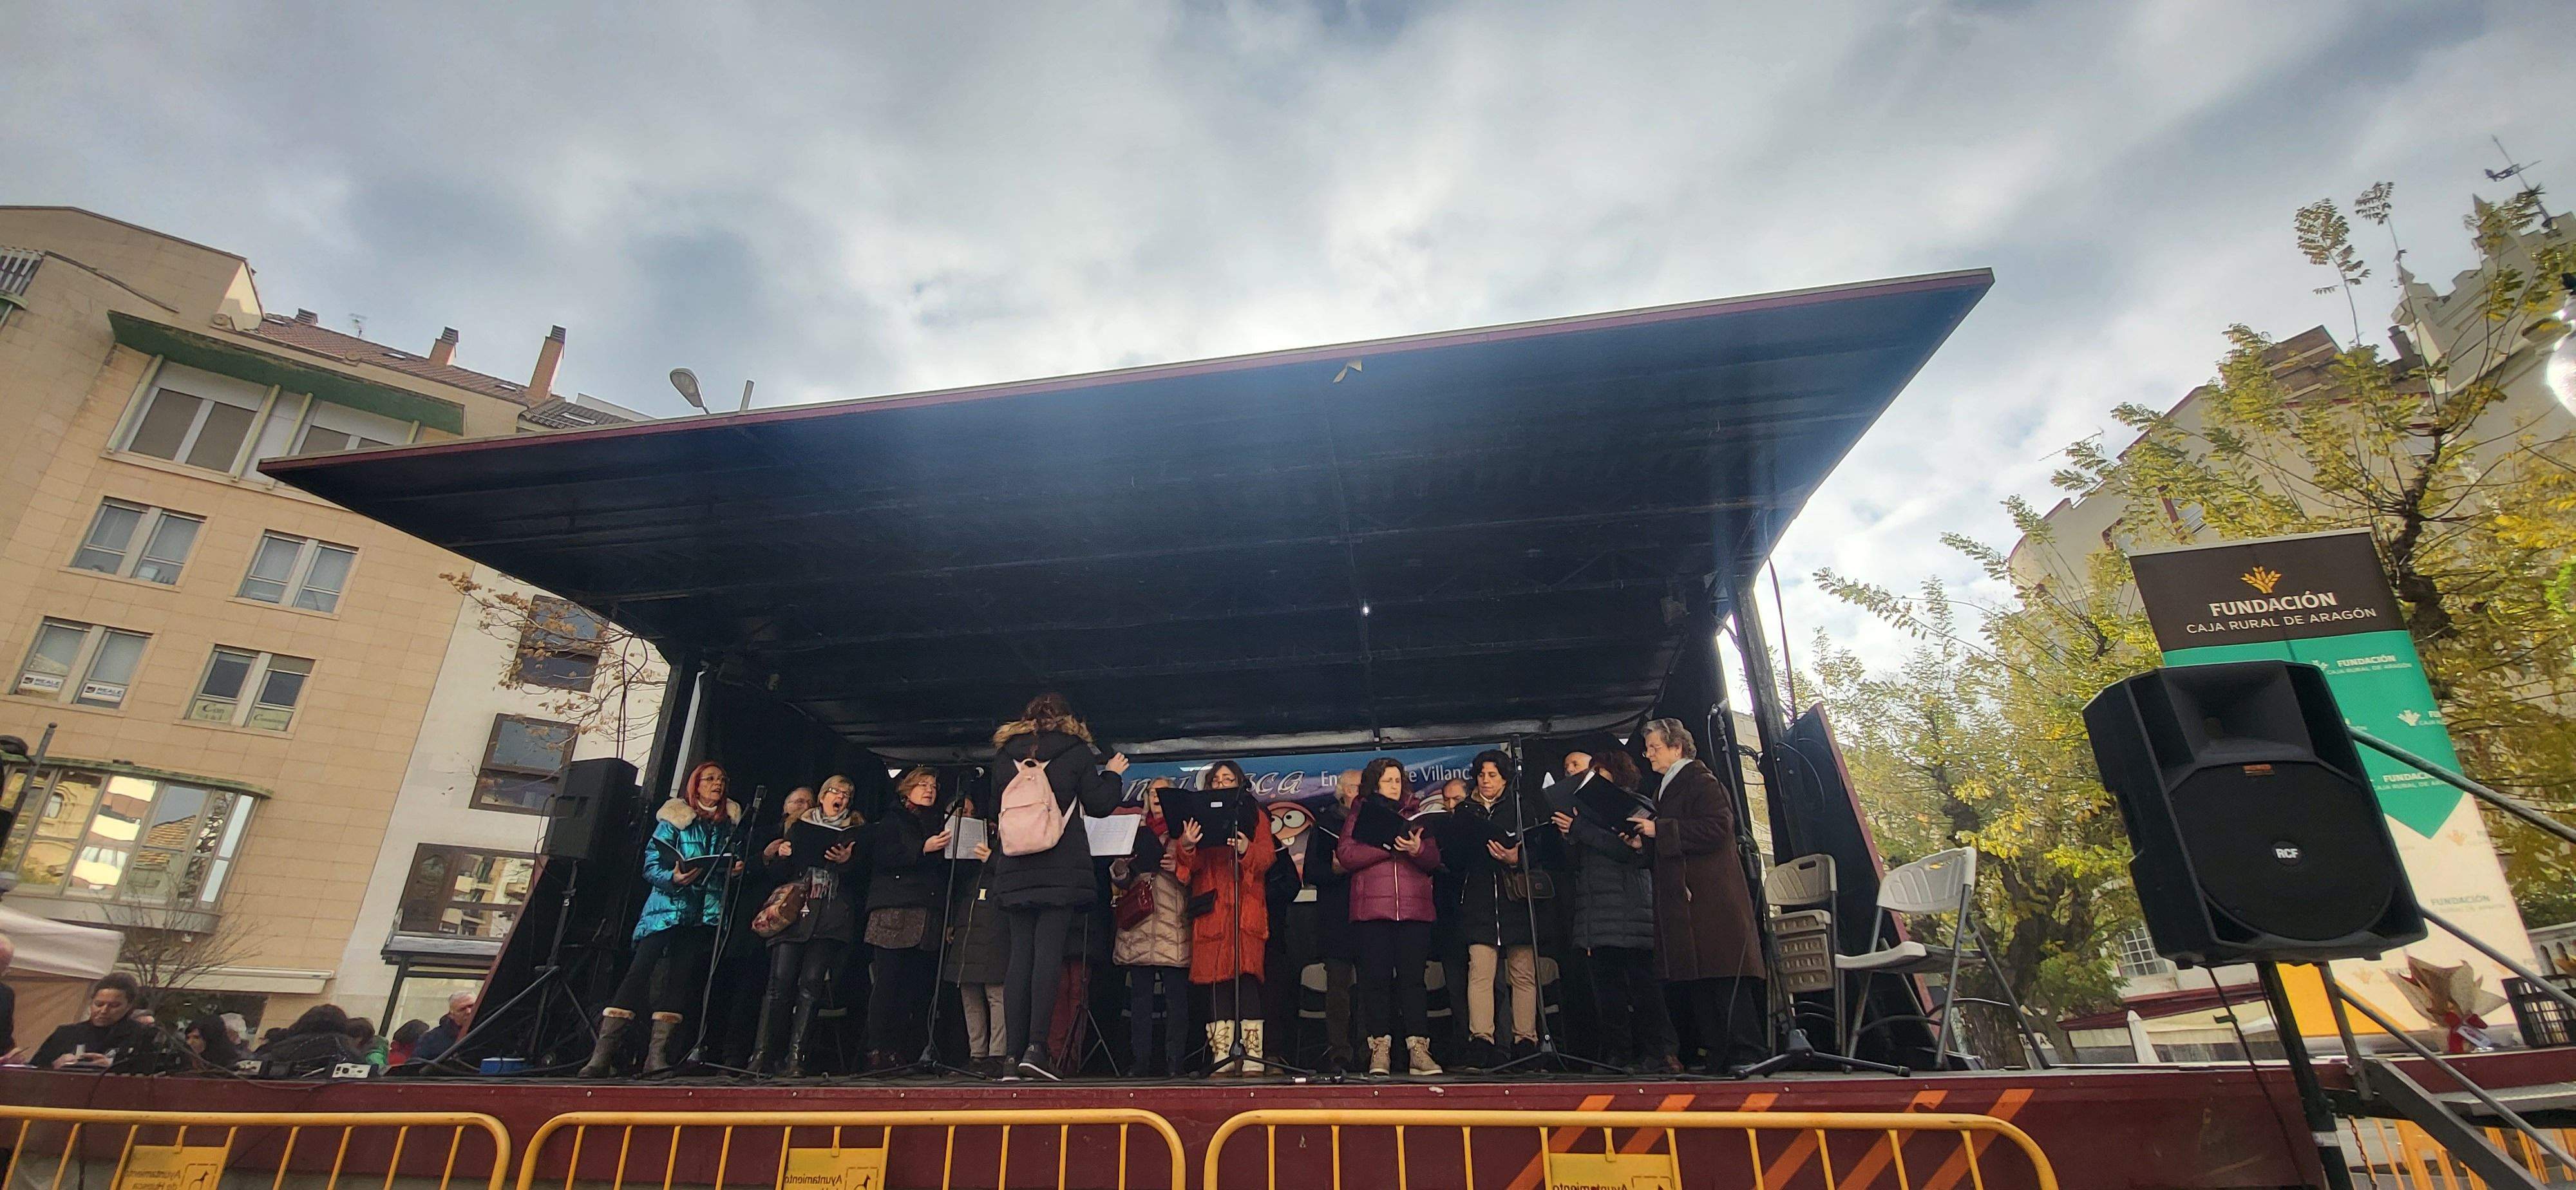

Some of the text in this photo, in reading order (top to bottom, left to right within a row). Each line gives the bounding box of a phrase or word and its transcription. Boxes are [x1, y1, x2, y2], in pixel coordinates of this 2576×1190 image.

[2209, 590, 2338, 617] FUNDACIÓN
[2186, 607, 2377, 634] CAJA RURAL DE ARAGÓN
[2336, 654, 2397, 667] FUNDACIÓN
[2382, 771, 2436, 782] FUNDACI
[2275, 848, 2299, 858] RCF
